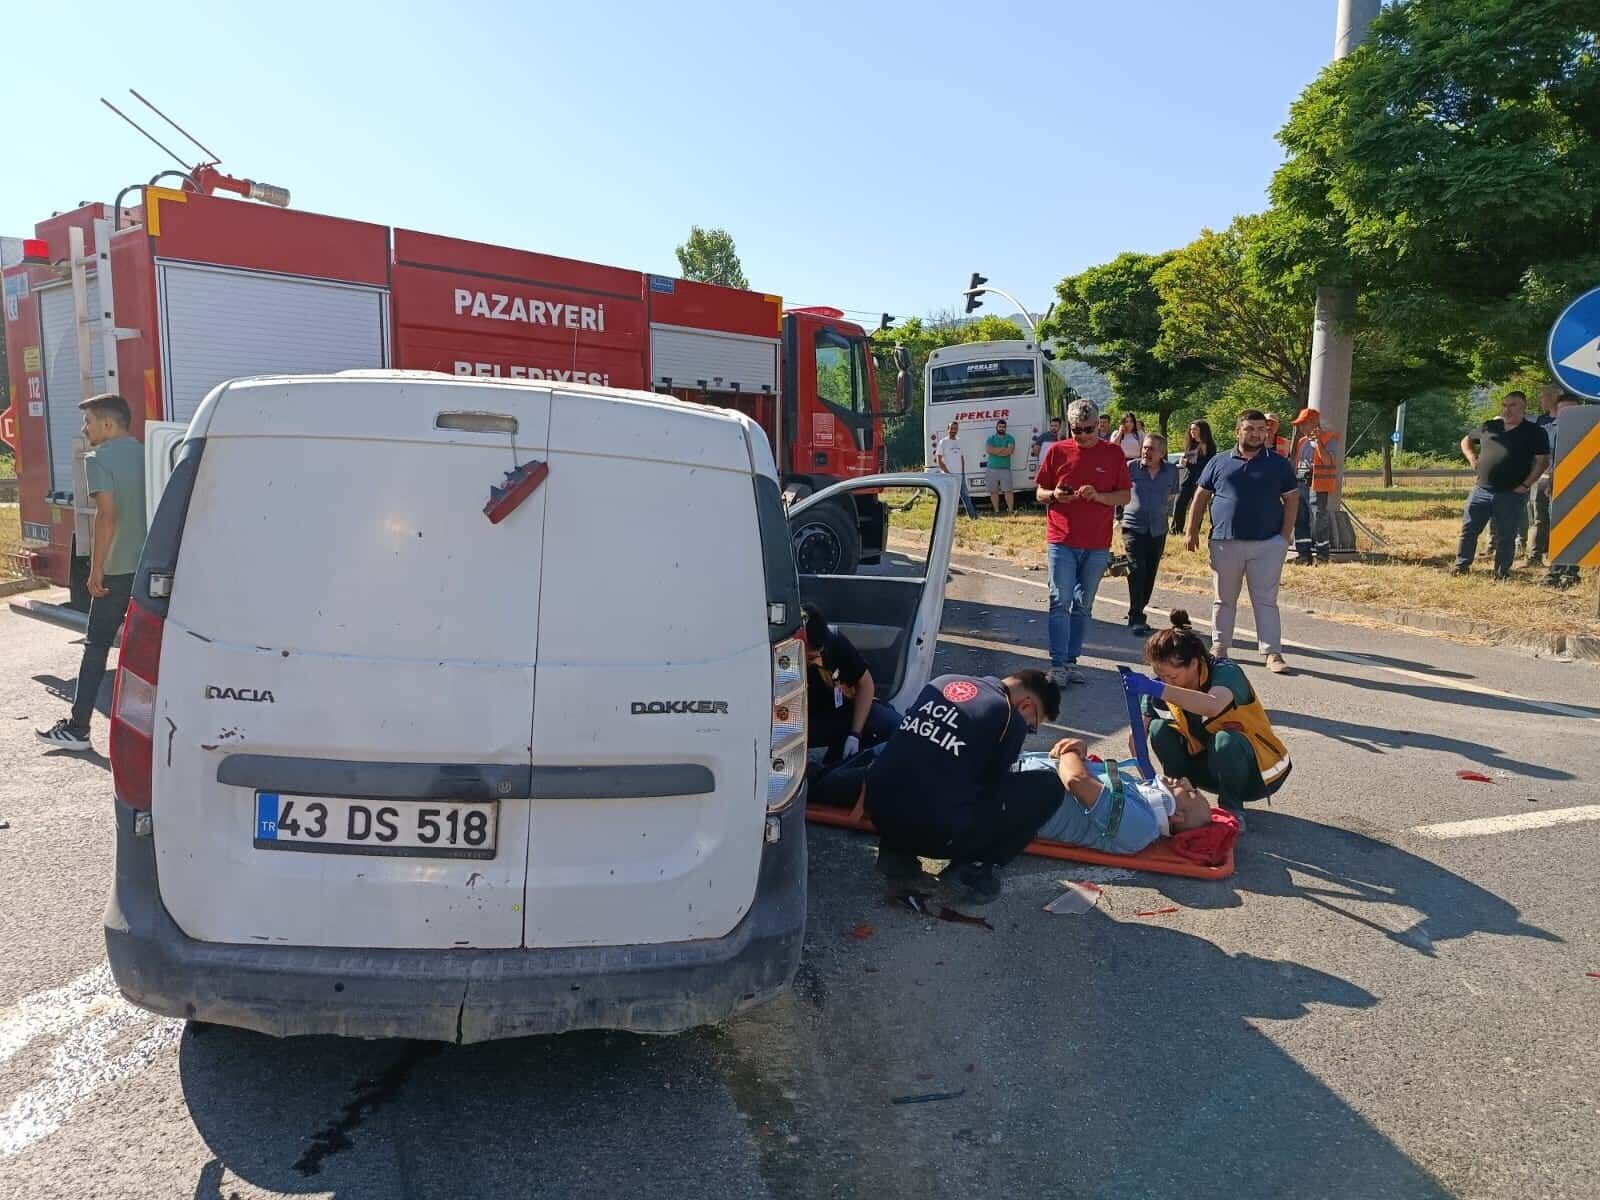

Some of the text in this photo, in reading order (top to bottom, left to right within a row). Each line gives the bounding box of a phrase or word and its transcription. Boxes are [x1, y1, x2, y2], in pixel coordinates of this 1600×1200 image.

[454, 288, 605, 332] PAZARYERİ
[205, 684, 275, 703] DACIA
[631, 700, 729, 714] DOKKER
[918, 700, 959, 729] ACİL
[899, 715, 967, 757] SAĞLIK
[262, 821, 276, 832] TR
[278, 801, 488, 846] 43 DS 518
